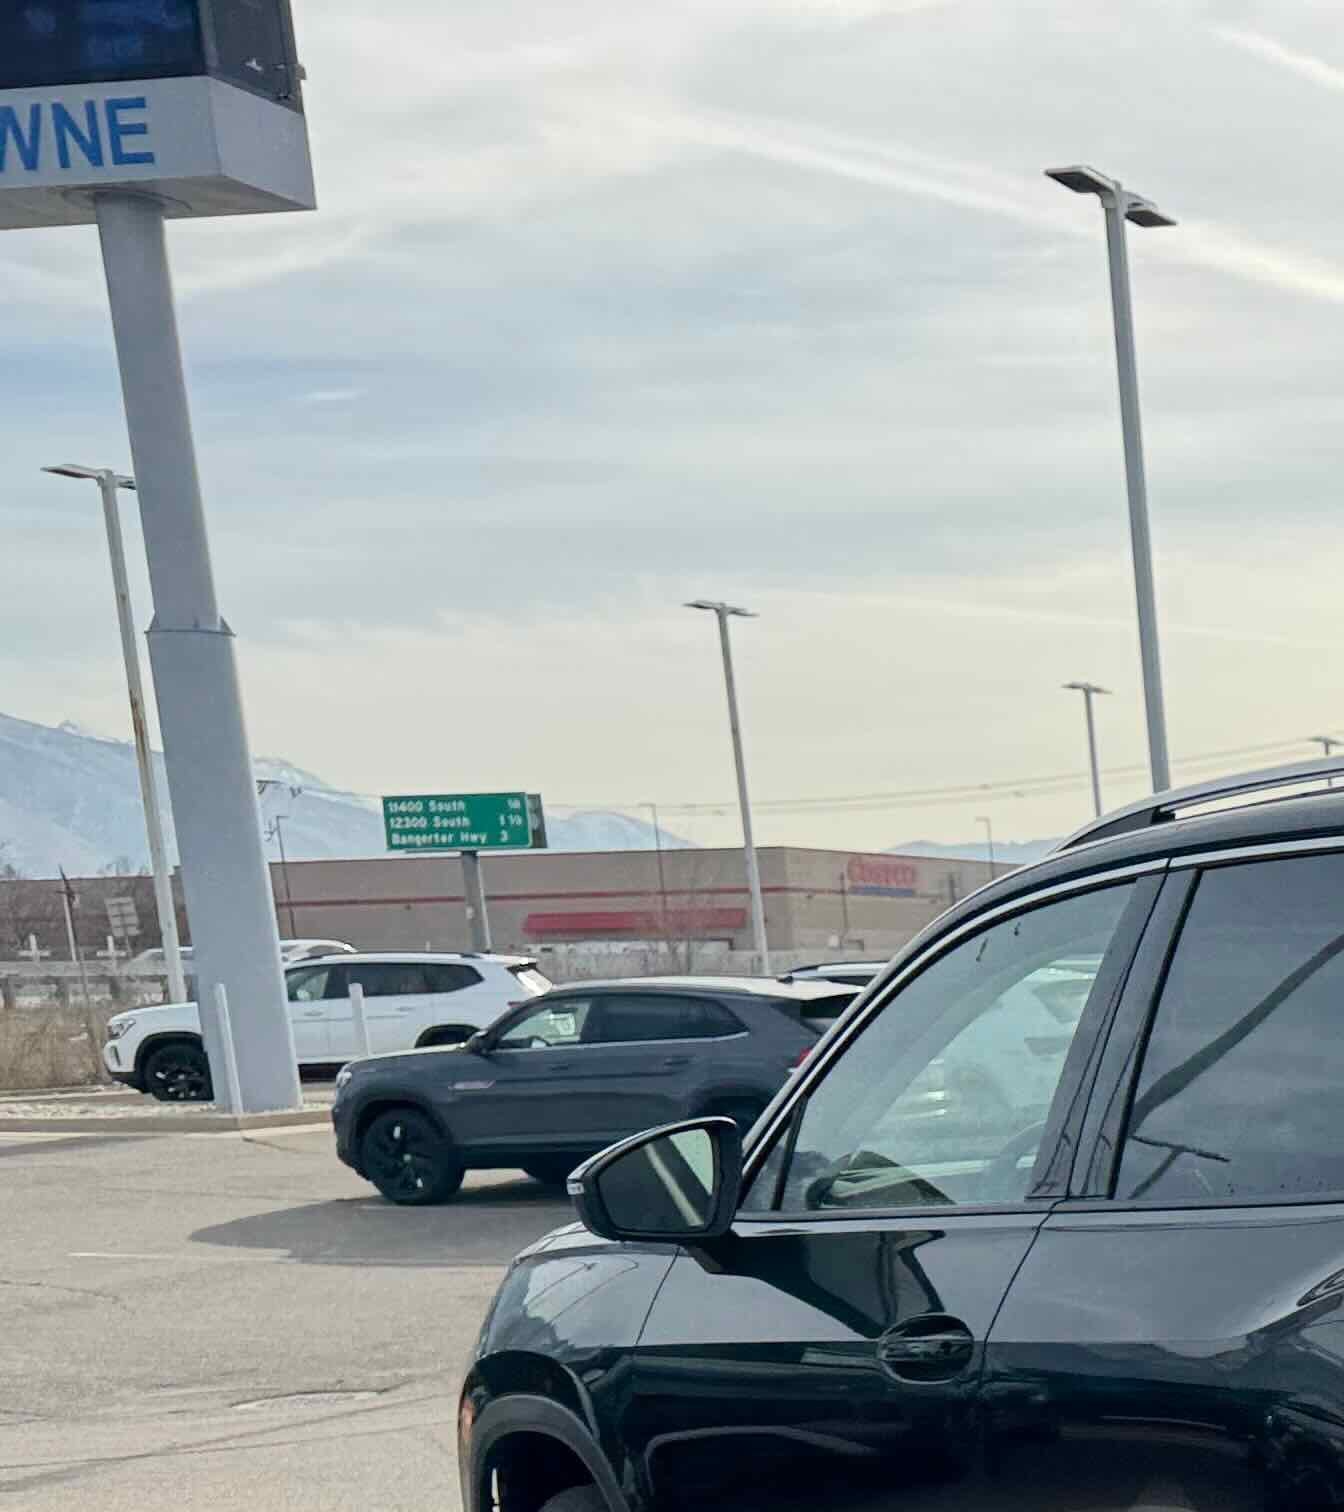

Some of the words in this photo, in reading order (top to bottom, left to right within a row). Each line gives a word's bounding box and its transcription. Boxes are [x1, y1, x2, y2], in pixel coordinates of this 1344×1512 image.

[388, 801, 424, 814] 11400
[429, 799, 466, 813] South
[433, 815, 472, 828] South
[391, 832, 455, 847] Bangerter
[460, 831, 488, 845] Hwy
